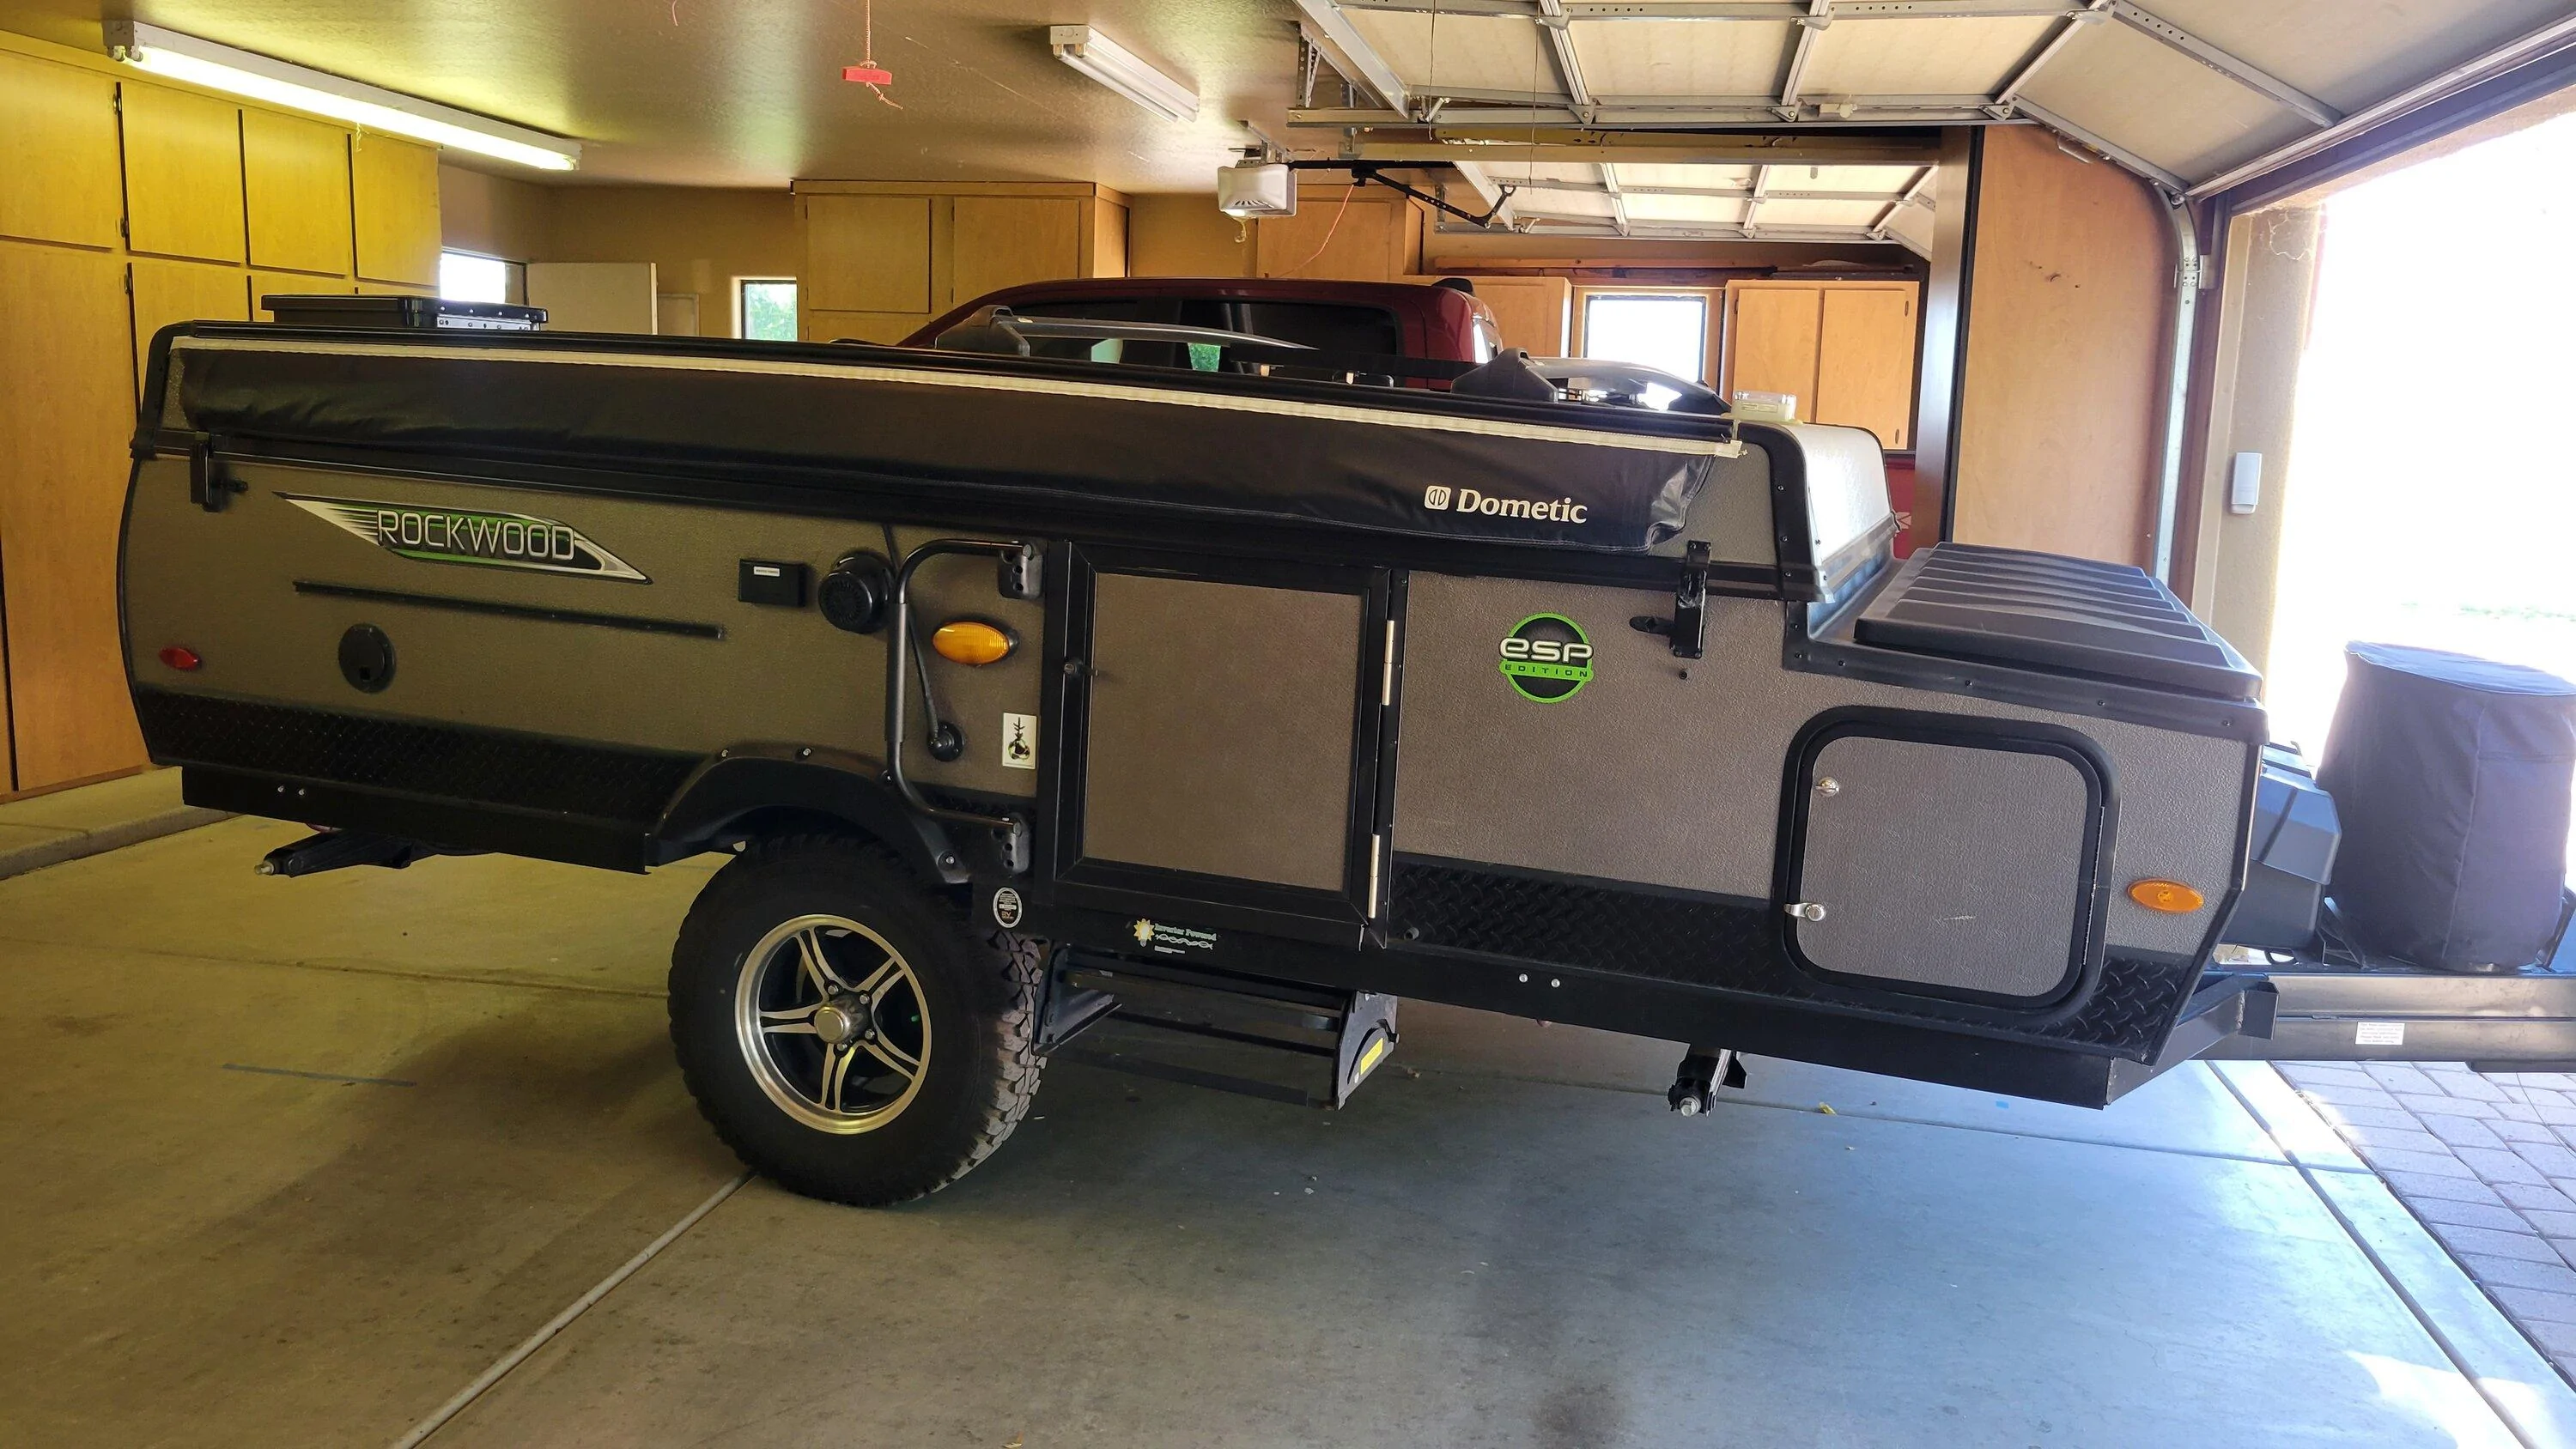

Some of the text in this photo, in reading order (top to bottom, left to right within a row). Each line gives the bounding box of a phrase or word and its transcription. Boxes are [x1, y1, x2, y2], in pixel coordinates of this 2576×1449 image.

[1456, 488, 1588, 524] Dometic
[377, 509, 575, 561] ROCKWOOD
[1504, 664, 1588, 677] EDITION
[1154, 923, 1217, 941] Inverter Powered
